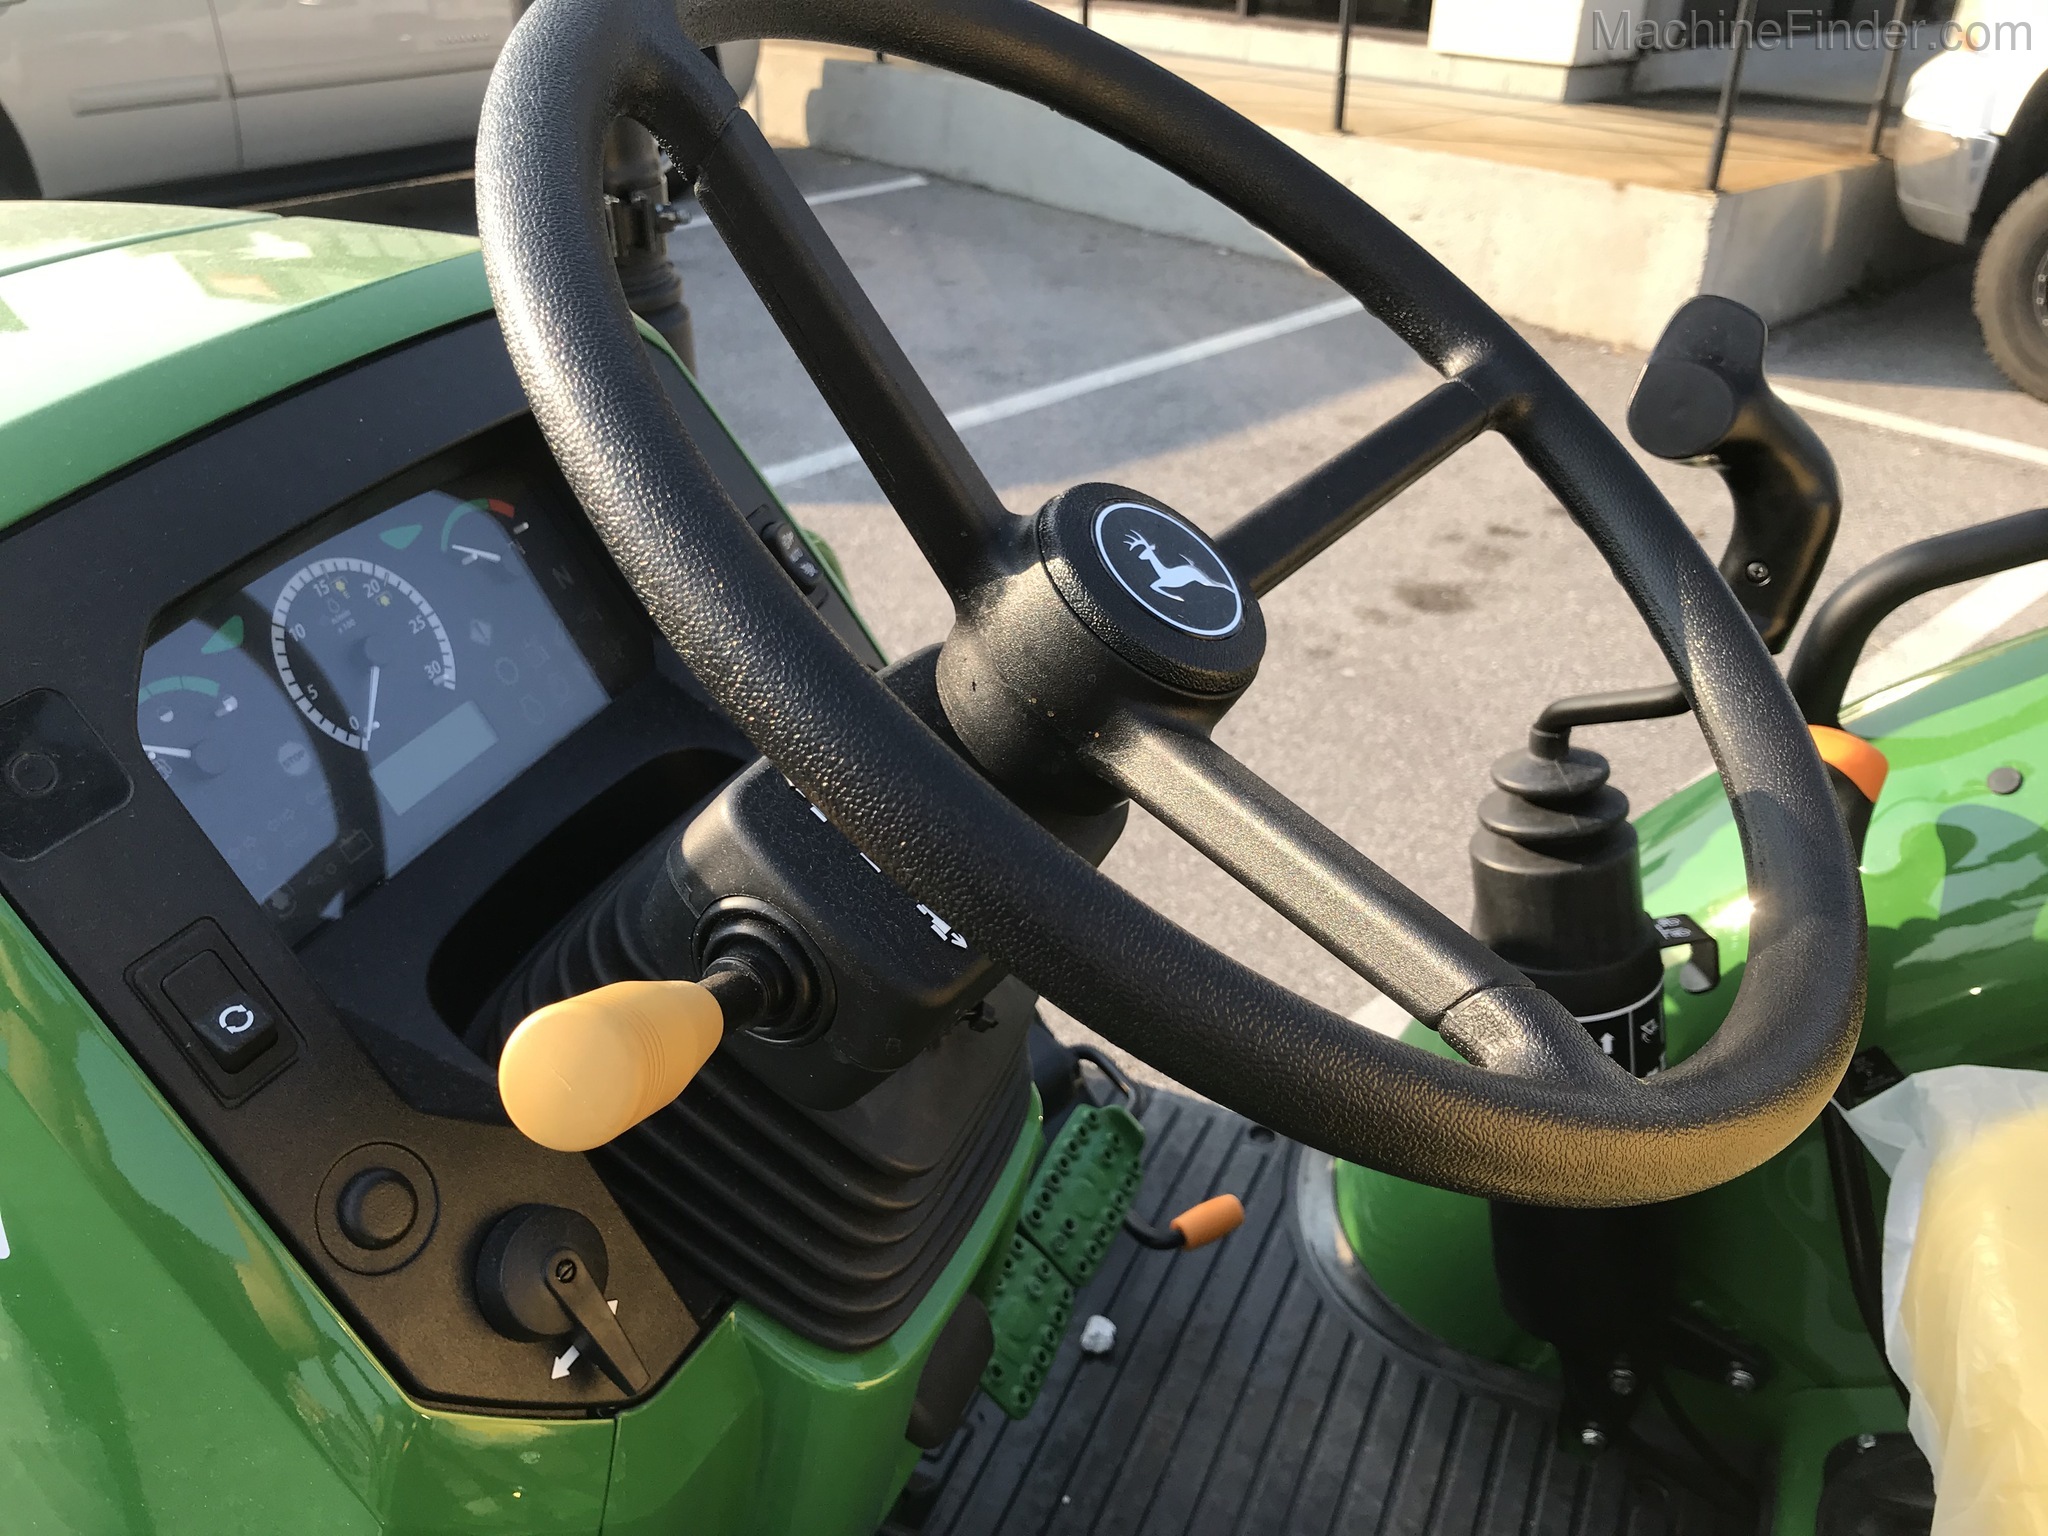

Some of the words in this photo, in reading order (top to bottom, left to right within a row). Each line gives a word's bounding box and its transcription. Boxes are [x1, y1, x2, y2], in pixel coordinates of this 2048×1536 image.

[313, 579, 330, 598] 15
[363, 579, 381, 599] 20
[289, 623, 306, 642] 10
[408, 614, 426, 635] 25
[424, 660, 441, 680] 30
[307, 683, 319, 701] 5
[348, 715, 360, 731] 0
